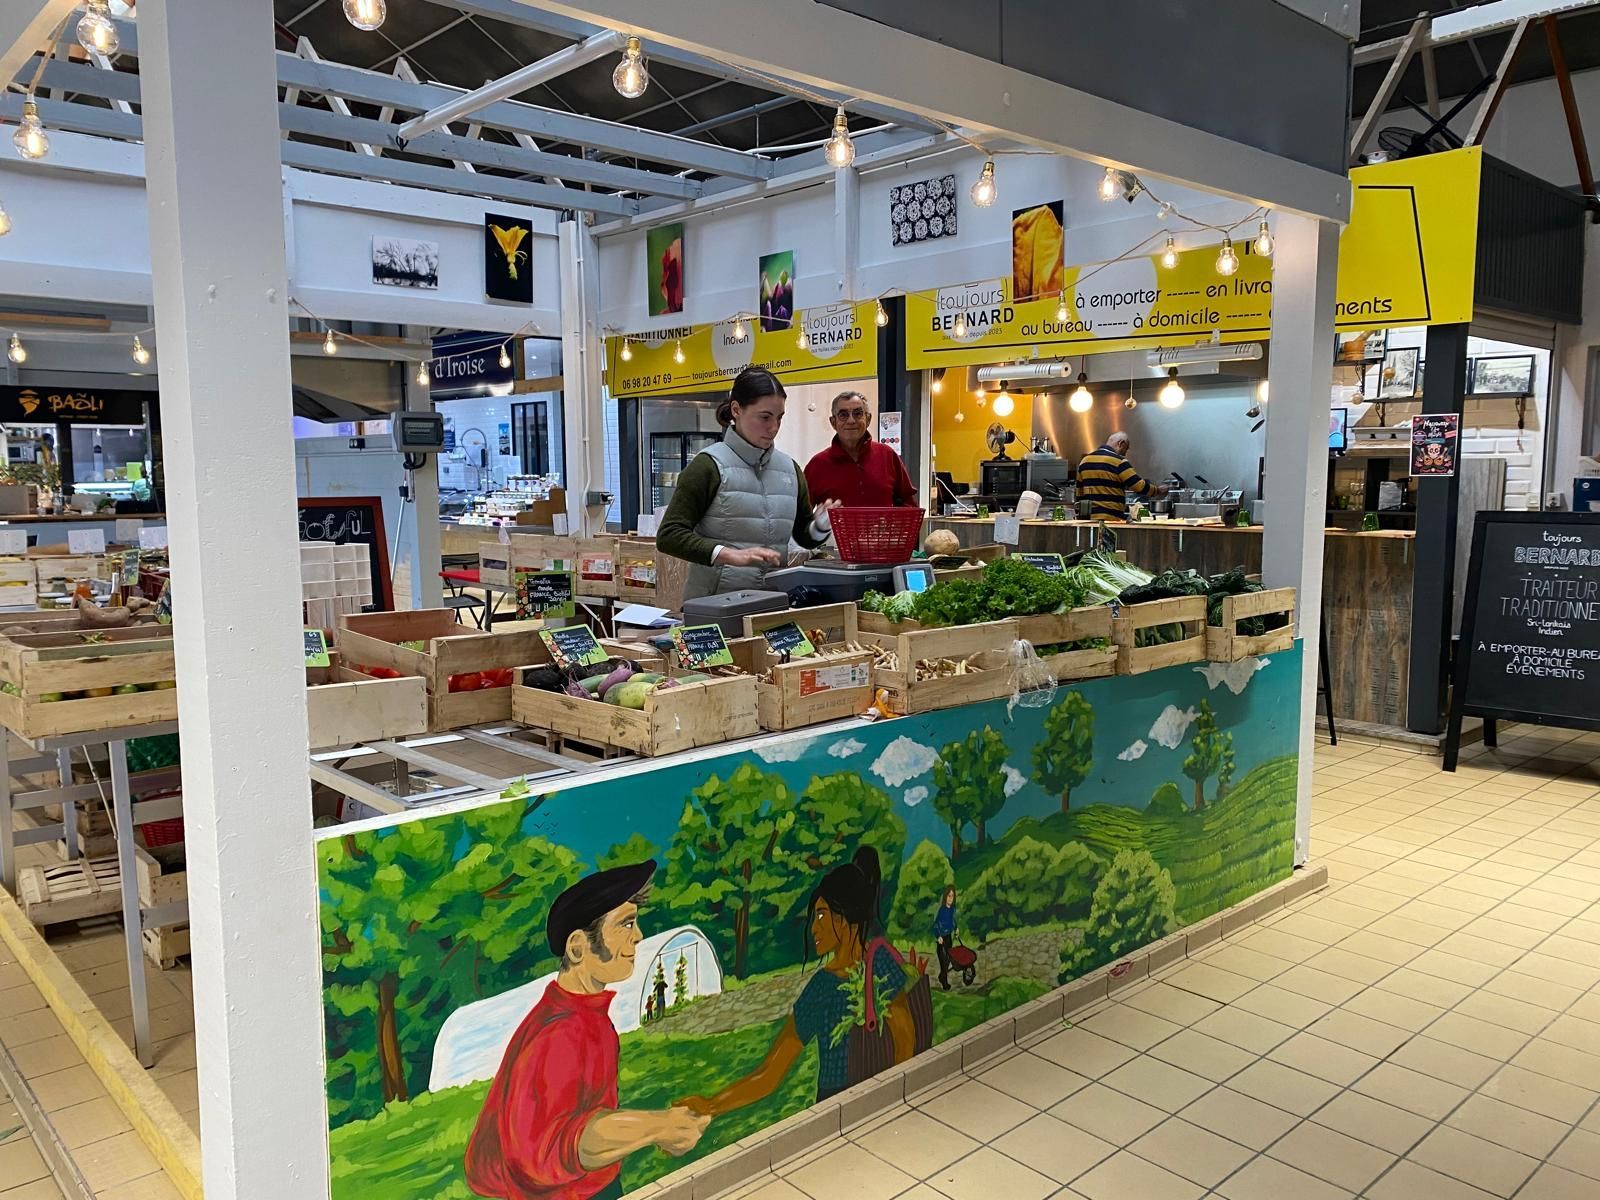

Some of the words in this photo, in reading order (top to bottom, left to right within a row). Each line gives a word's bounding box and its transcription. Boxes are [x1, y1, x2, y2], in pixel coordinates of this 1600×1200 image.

[940, 289, 1004, 312] toujours
[1076, 293, 1085, 308] à
[1091, 289, 1162, 310] emporter
[1206, 284, 1227, 297] en
[810, 314, 855, 331] toujours
[1021, 324, 1038, 336] au
[1043, 319, 1092, 335] bureau
[1133, 313, 1143, 329] à
[1150, 307, 1220, 327] domicile
[435, 355, 486, 378] d'Iroise
[623, 380, 631, 389] 06
[632, 378, 641, 388] 98
[643, 376, 651, 386] 20
[652, 375, 661, 384] 47
[663, 373, 672, 383] 69
[1543, 530, 1582, 547] toujours
[1520, 579, 1597, 600] TRAITEUR
[1523, 656, 1573, 668] DOMICILE
